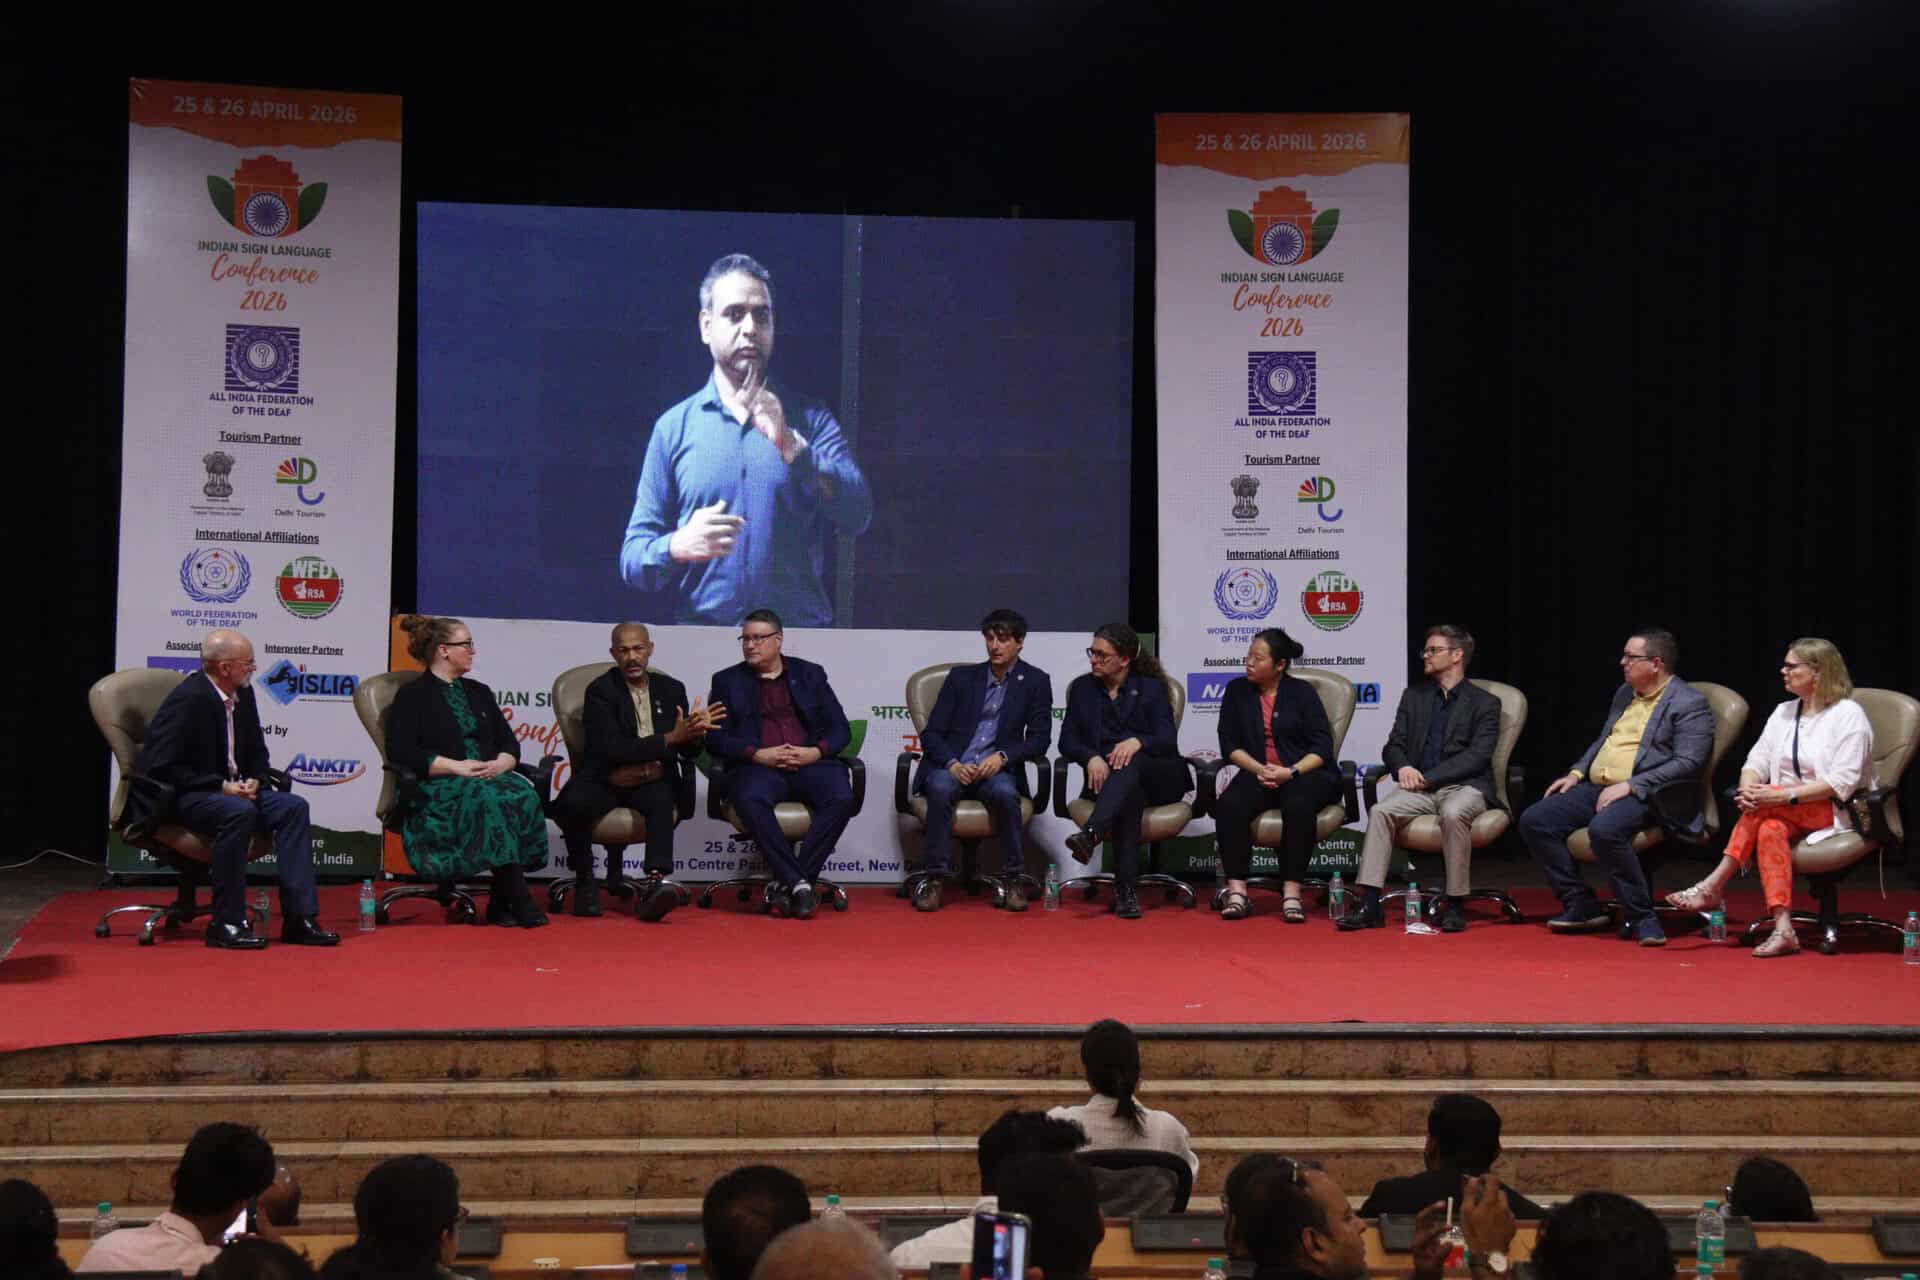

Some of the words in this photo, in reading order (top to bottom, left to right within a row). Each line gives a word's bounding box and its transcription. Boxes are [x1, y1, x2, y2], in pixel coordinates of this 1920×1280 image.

[173, 96, 198, 113] 25
[203, 97, 215, 115] &
[220, 98, 245, 117] 26
[250, 101, 303, 121] APRIL
[308, 104, 358, 124] 2026
[1196, 134, 1217, 150] 25
[1222, 134, 1233, 149] &
[1240, 134, 1262, 150] 26
[1266, 134, 1316, 150] APRIL
[1322, 133, 1368, 150] 2026
[198, 240, 238, 254] INDIAN
[241, 242, 269, 255] SIGN
[271, 244, 332, 259] LANGUAGE
[211, 253, 319, 287] Conference
[1221, 272, 1258, 283] INDIAN
[1260, 272, 1286, 283] SIGN
[1288, 272, 1344, 283] LANGUAGE
[239, 290, 288, 312] 2026
[1232, 283, 1334, 314] Conference
[1260, 318, 1304, 337] 2026
[209, 391, 226, 402] ALL
[228, 392, 255, 404] INDIA
[257, 394, 314, 406] FEDERATION
[232, 405, 245, 415] OF
[247, 406, 266, 416] THE
[268, 407, 292, 417] DEAF
[1234, 417, 1250, 427] ALL
[1252, 417, 1276, 427] INDIA
[1278, 417, 1330, 427] FEDERATION
[219, 431, 261, 444] Tourism
[264, 432, 302, 445] Partner
[1256, 430, 1268, 439] OF
[1270, 430, 1287, 439] THE
[1289, 430, 1311, 439] DEAF
[1245, 454, 1283, 465] Tourism
[1285, 454, 1321, 465] Partner
[195, 528, 262, 541] International
[265, 531, 319, 544] Affiliations
[1226, 550, 1287, 560] International
[1288, 549, 1340, 560] Affiliations
[292, 560, 330, 578] WFD
[1315, 575, 1352, 592] WFD
[307, 588, 325, 600] RSA
[1330, 601, 1347, 611] RSA
[171, 609, 201, 618] WORLD
[204, 610, 257, 620] FEDERATION
[186, 618, 198, 627] OF
[200, 618, 217, 627] THE
[219, 619, 242, 628] DEAF
[1207, 627, 1235, 635] WORLD
[166, 640, 202, 650] Associat
[1221, 635, 1232, 643] OF
[1234, 635, 1249, 643] THE
[265, 643, 310, 655] Interpreter
[312, 645, 344, 656] Partner
[1203, 657, 1241, 666] Associate
[1336, 656, 1366, 665] Partner
[275, 725, 288, 737] by
[288, 752, 360, 773] ANKIT
[704, 842, 723, 852] 25
[727, 841, 737, 852] &
[323, 852, 353, 865] India
[688, 858, 735, 870] Centre
[868, 859, 900, 871] New
[1320, 854, 1353, 867] Delhi,
